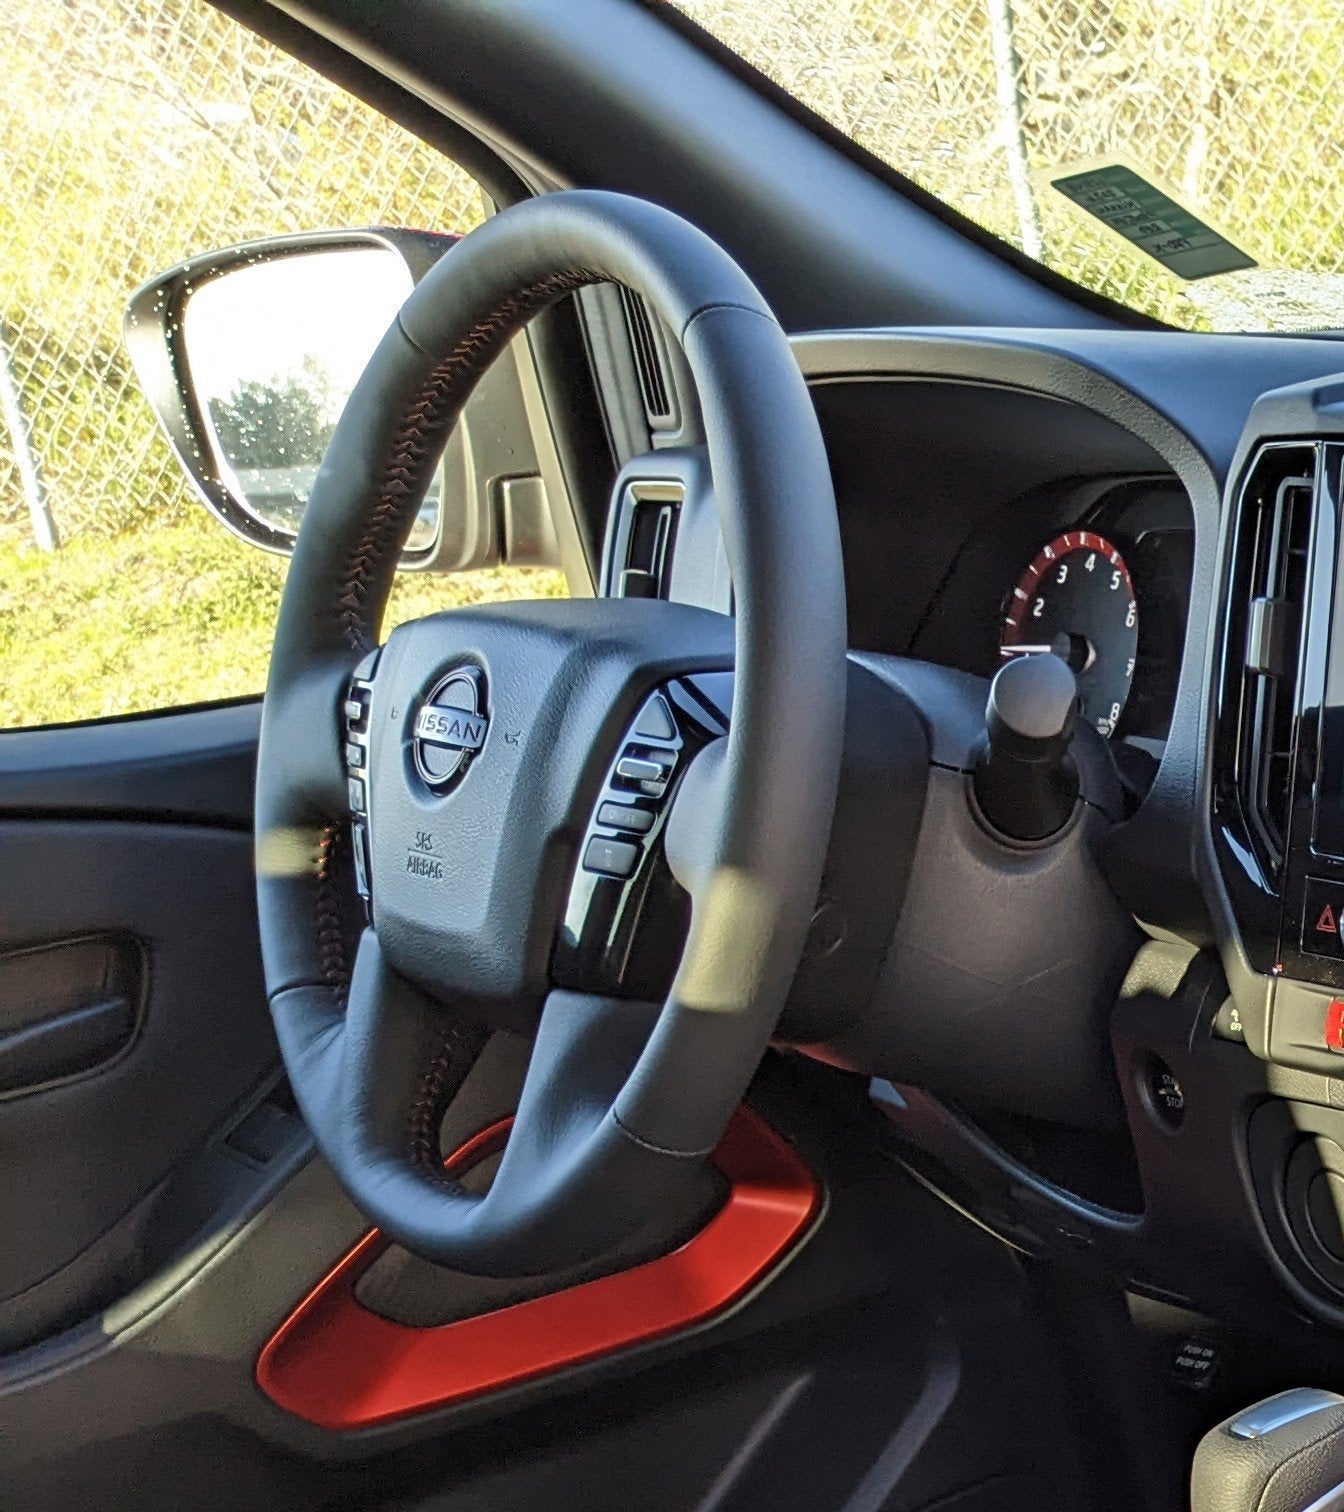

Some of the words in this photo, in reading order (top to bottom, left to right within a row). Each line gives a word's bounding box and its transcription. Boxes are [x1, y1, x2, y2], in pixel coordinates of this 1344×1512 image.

[1084, 552, 1096, 572] 4
[1056, 565, 1068, 584] 3
[1110, 571, 1122, 590] 5
[1033, 597, 1045, 617] 2
[418, 712, 482, 743] ISSAN
